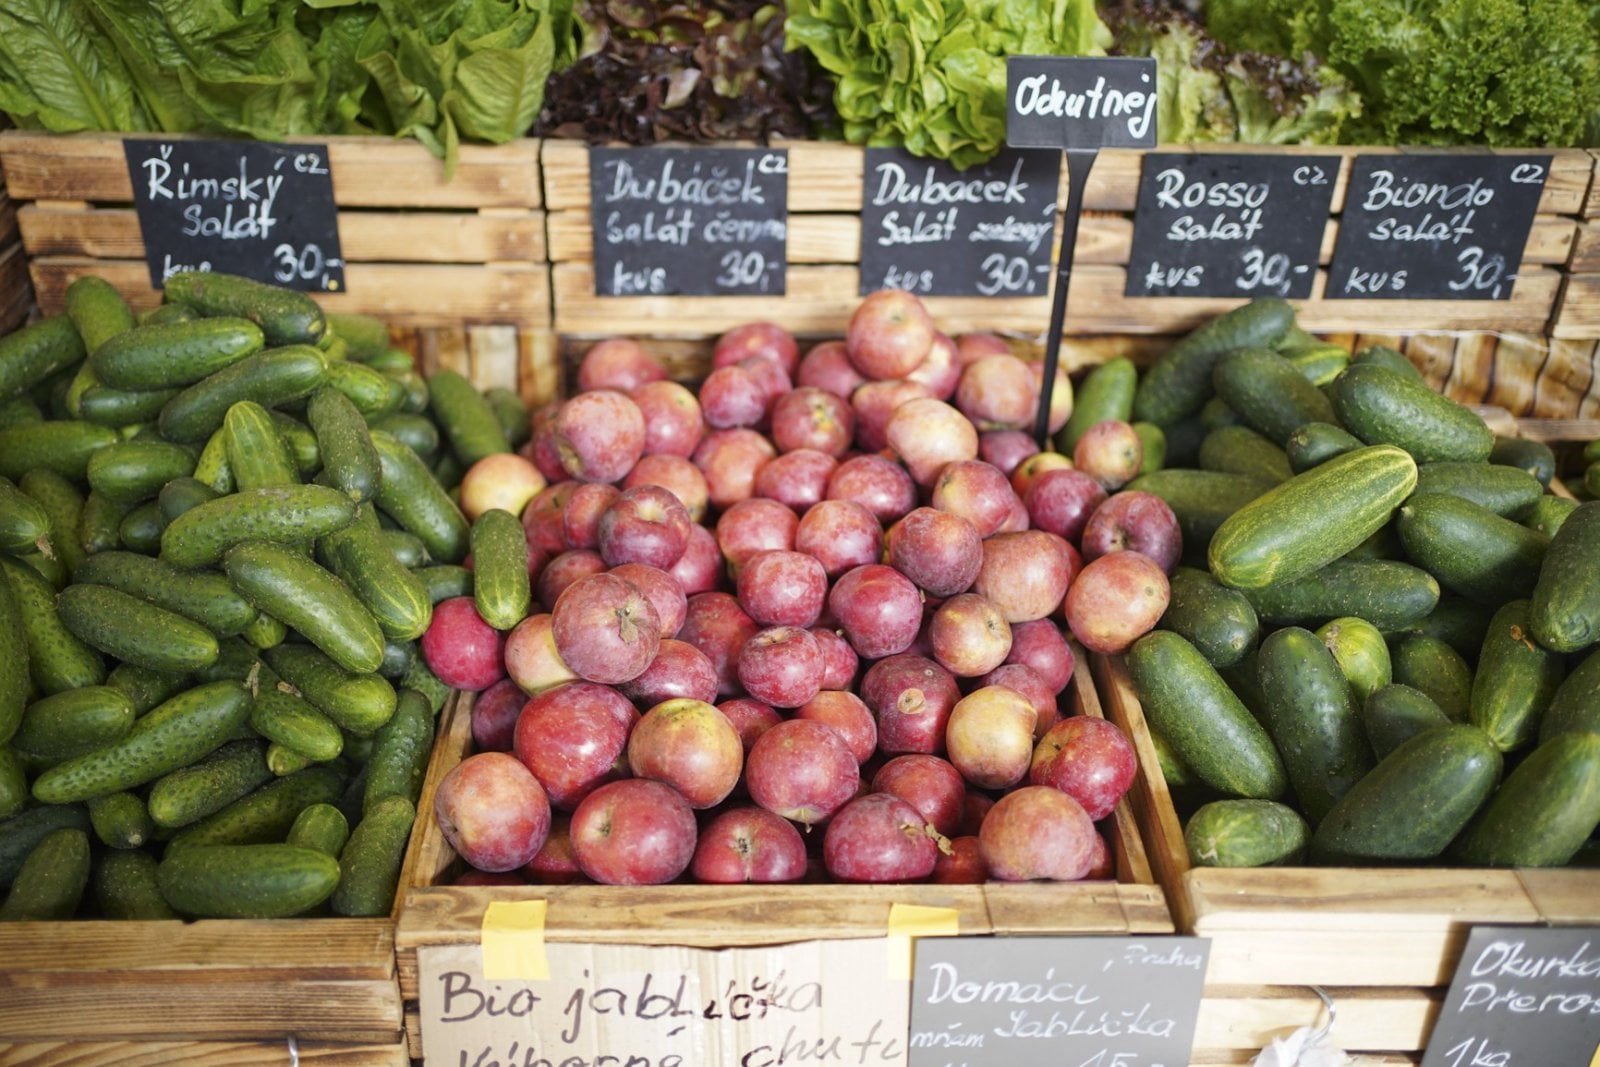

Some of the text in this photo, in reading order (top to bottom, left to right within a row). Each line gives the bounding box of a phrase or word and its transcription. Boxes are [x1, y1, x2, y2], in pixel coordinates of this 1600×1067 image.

[1155, 168, 1270, 209] Rosso
[1362, 169, 1495, 212] Biondo
[612, 260, 668, 296] kus
[882, 263, 934, 292] kus
[438, 970, 542, 1023] Bio
